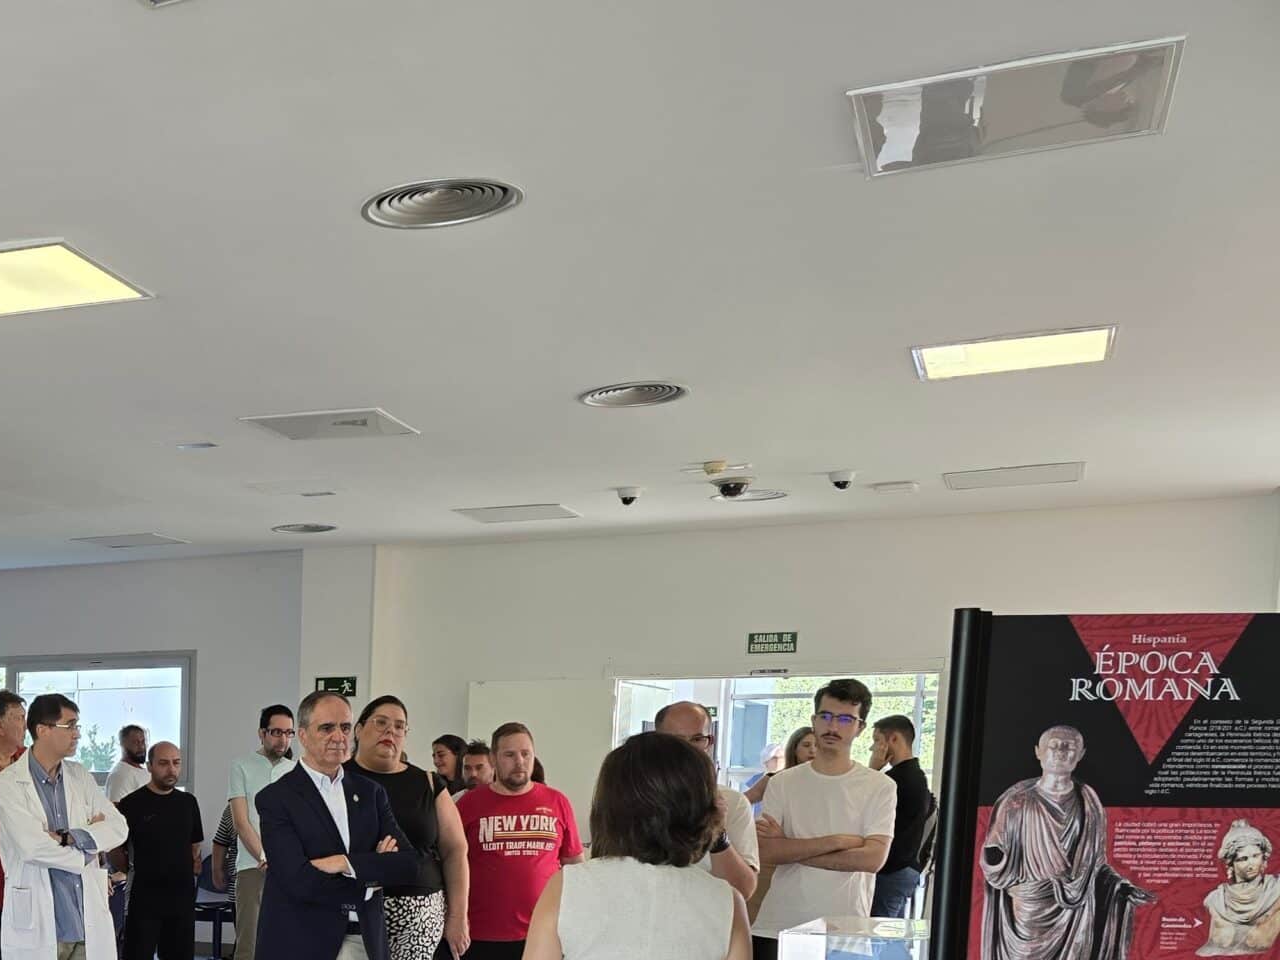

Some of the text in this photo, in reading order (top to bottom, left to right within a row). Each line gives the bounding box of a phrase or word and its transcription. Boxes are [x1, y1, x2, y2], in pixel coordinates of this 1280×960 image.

[750, 642, 795, 652] EMERGENCIA
[753, 633, 793, 643] SALIDA DE
[1131, 634, 1187, 647] Hispania
[1093, 644, 1221, 675] ÉPOCA
[1069, 677, 1241, 701] ROMANA
[479, 814, 558, 843] NEW YORK
